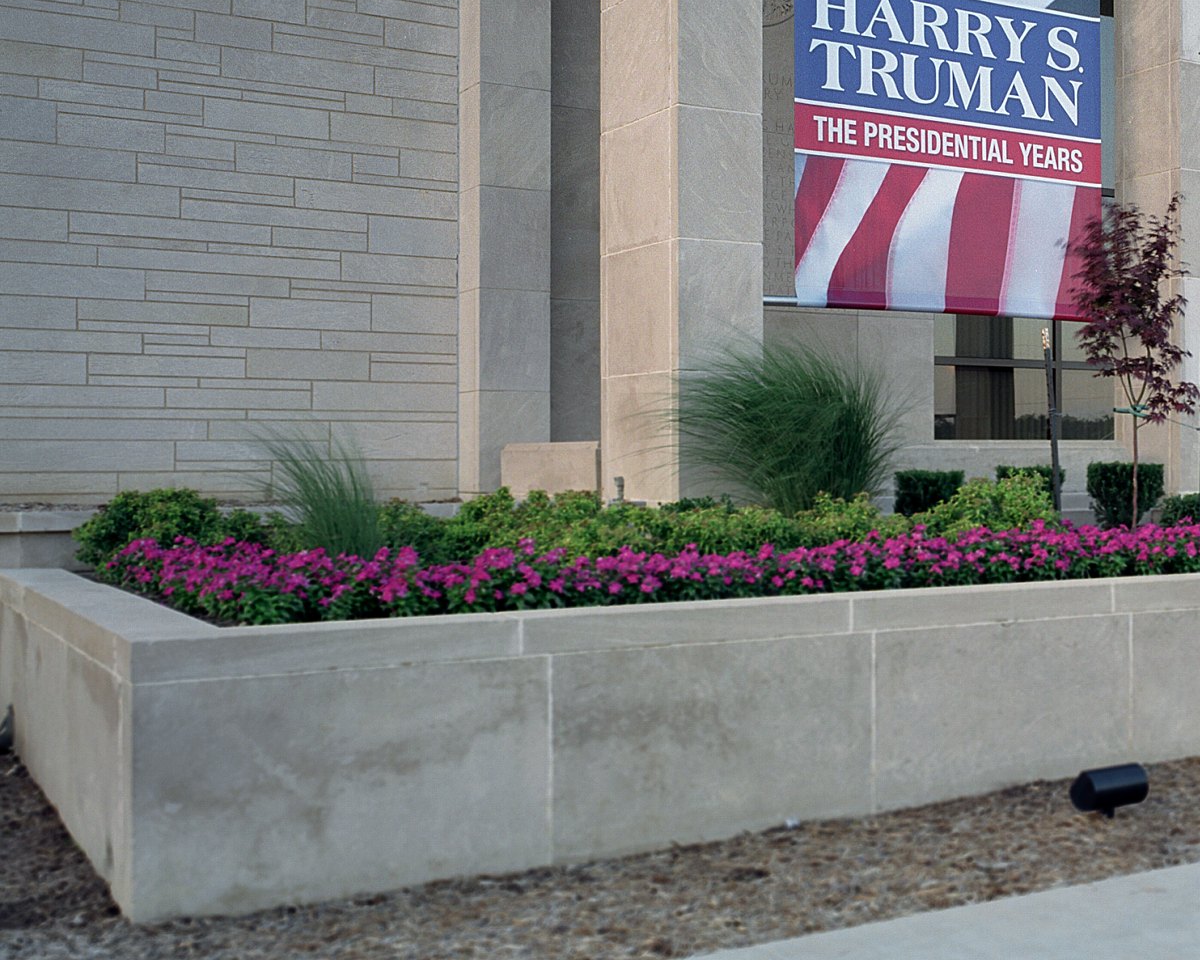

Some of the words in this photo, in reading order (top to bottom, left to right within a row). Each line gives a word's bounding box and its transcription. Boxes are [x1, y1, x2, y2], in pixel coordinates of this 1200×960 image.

[1045, 26, 1085, 74] S.
[809, 38, 1084, 127] TRUMAN
[813, 115, 857, 145] THE
[863, 121, 1014, 164] PRESIDENTIAL
[1019, 142, 1084, 174] YEARS
